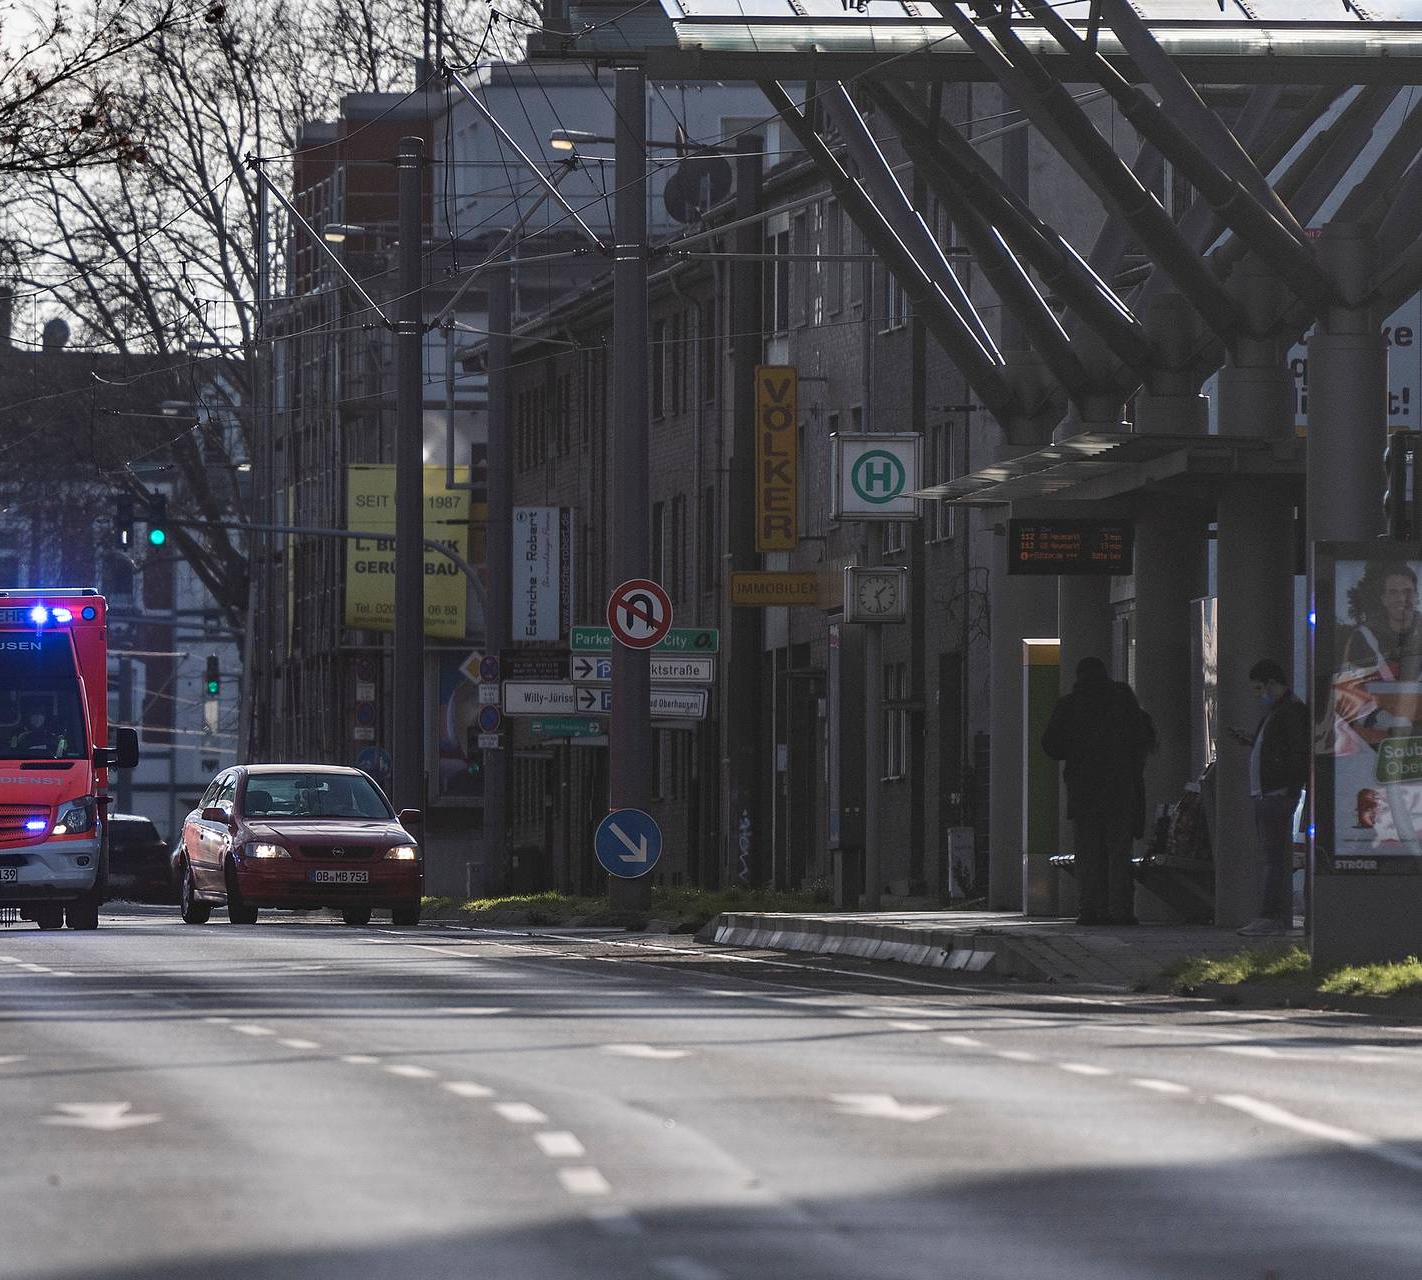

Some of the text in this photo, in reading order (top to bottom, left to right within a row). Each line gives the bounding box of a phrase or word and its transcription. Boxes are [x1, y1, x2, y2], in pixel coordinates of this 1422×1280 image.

[762, 378, 793, 540] VÖLKER
[865, 462, 891, 492] H
[355, 495, 462, 508] SEIT 1987
[525, 511, 538, 561] Robert
[736, 582, 818, 595] IMMOBILIEN
[525, 577, 538, 636] Estriche
[575, 633, 612, 645] Parke
[663, 634, 688, 648] City
[650, 665, 700, 676] ktstraße
[523, 692, 573, 705] Willy-Jüriss
[659, 698, 698, 710] Oberhausen
[316, 871, 329, 882] OB
[349, 872, 367, 882] 751
